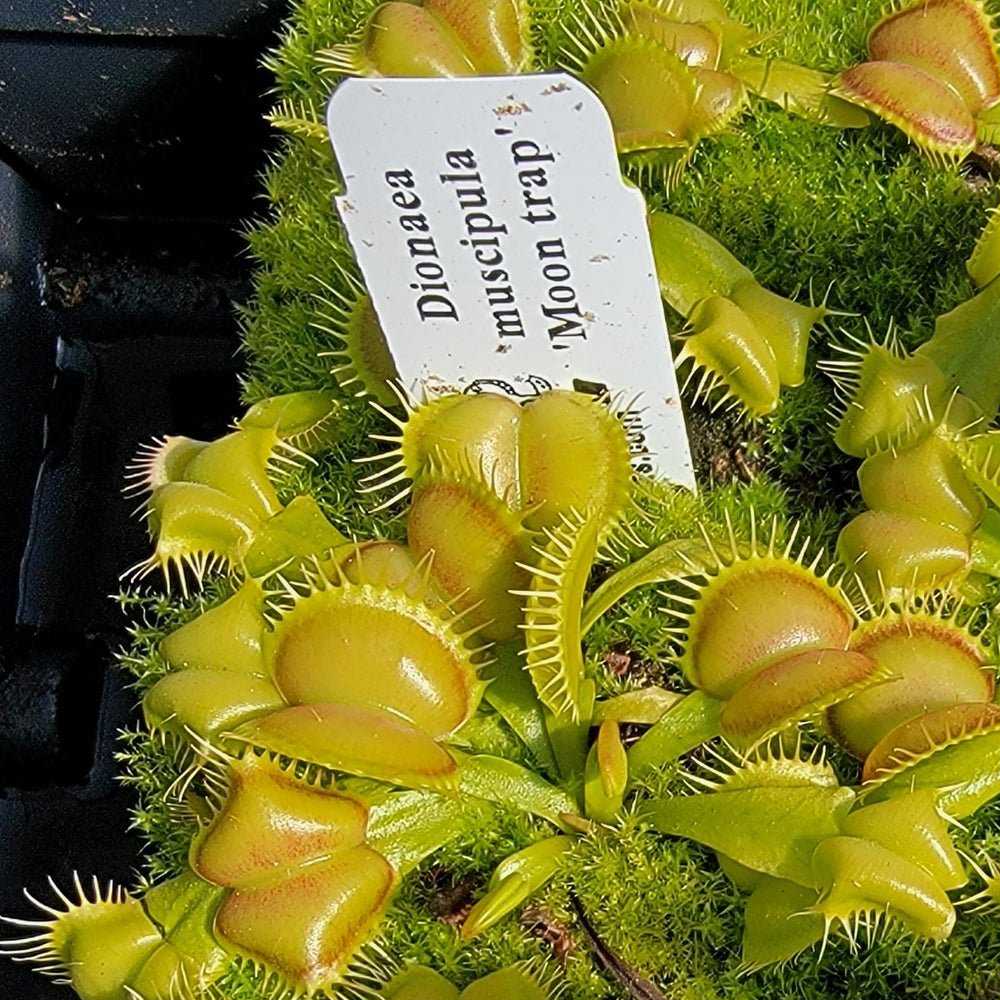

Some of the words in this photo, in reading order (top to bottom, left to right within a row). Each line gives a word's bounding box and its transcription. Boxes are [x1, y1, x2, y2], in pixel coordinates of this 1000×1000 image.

[494, 128, 557, 224] trap'
[385, 169, 459, 322] Dionaea
[440, 148, 526, 339] muscipula
[535, 238, 587, 350] 'Moon
